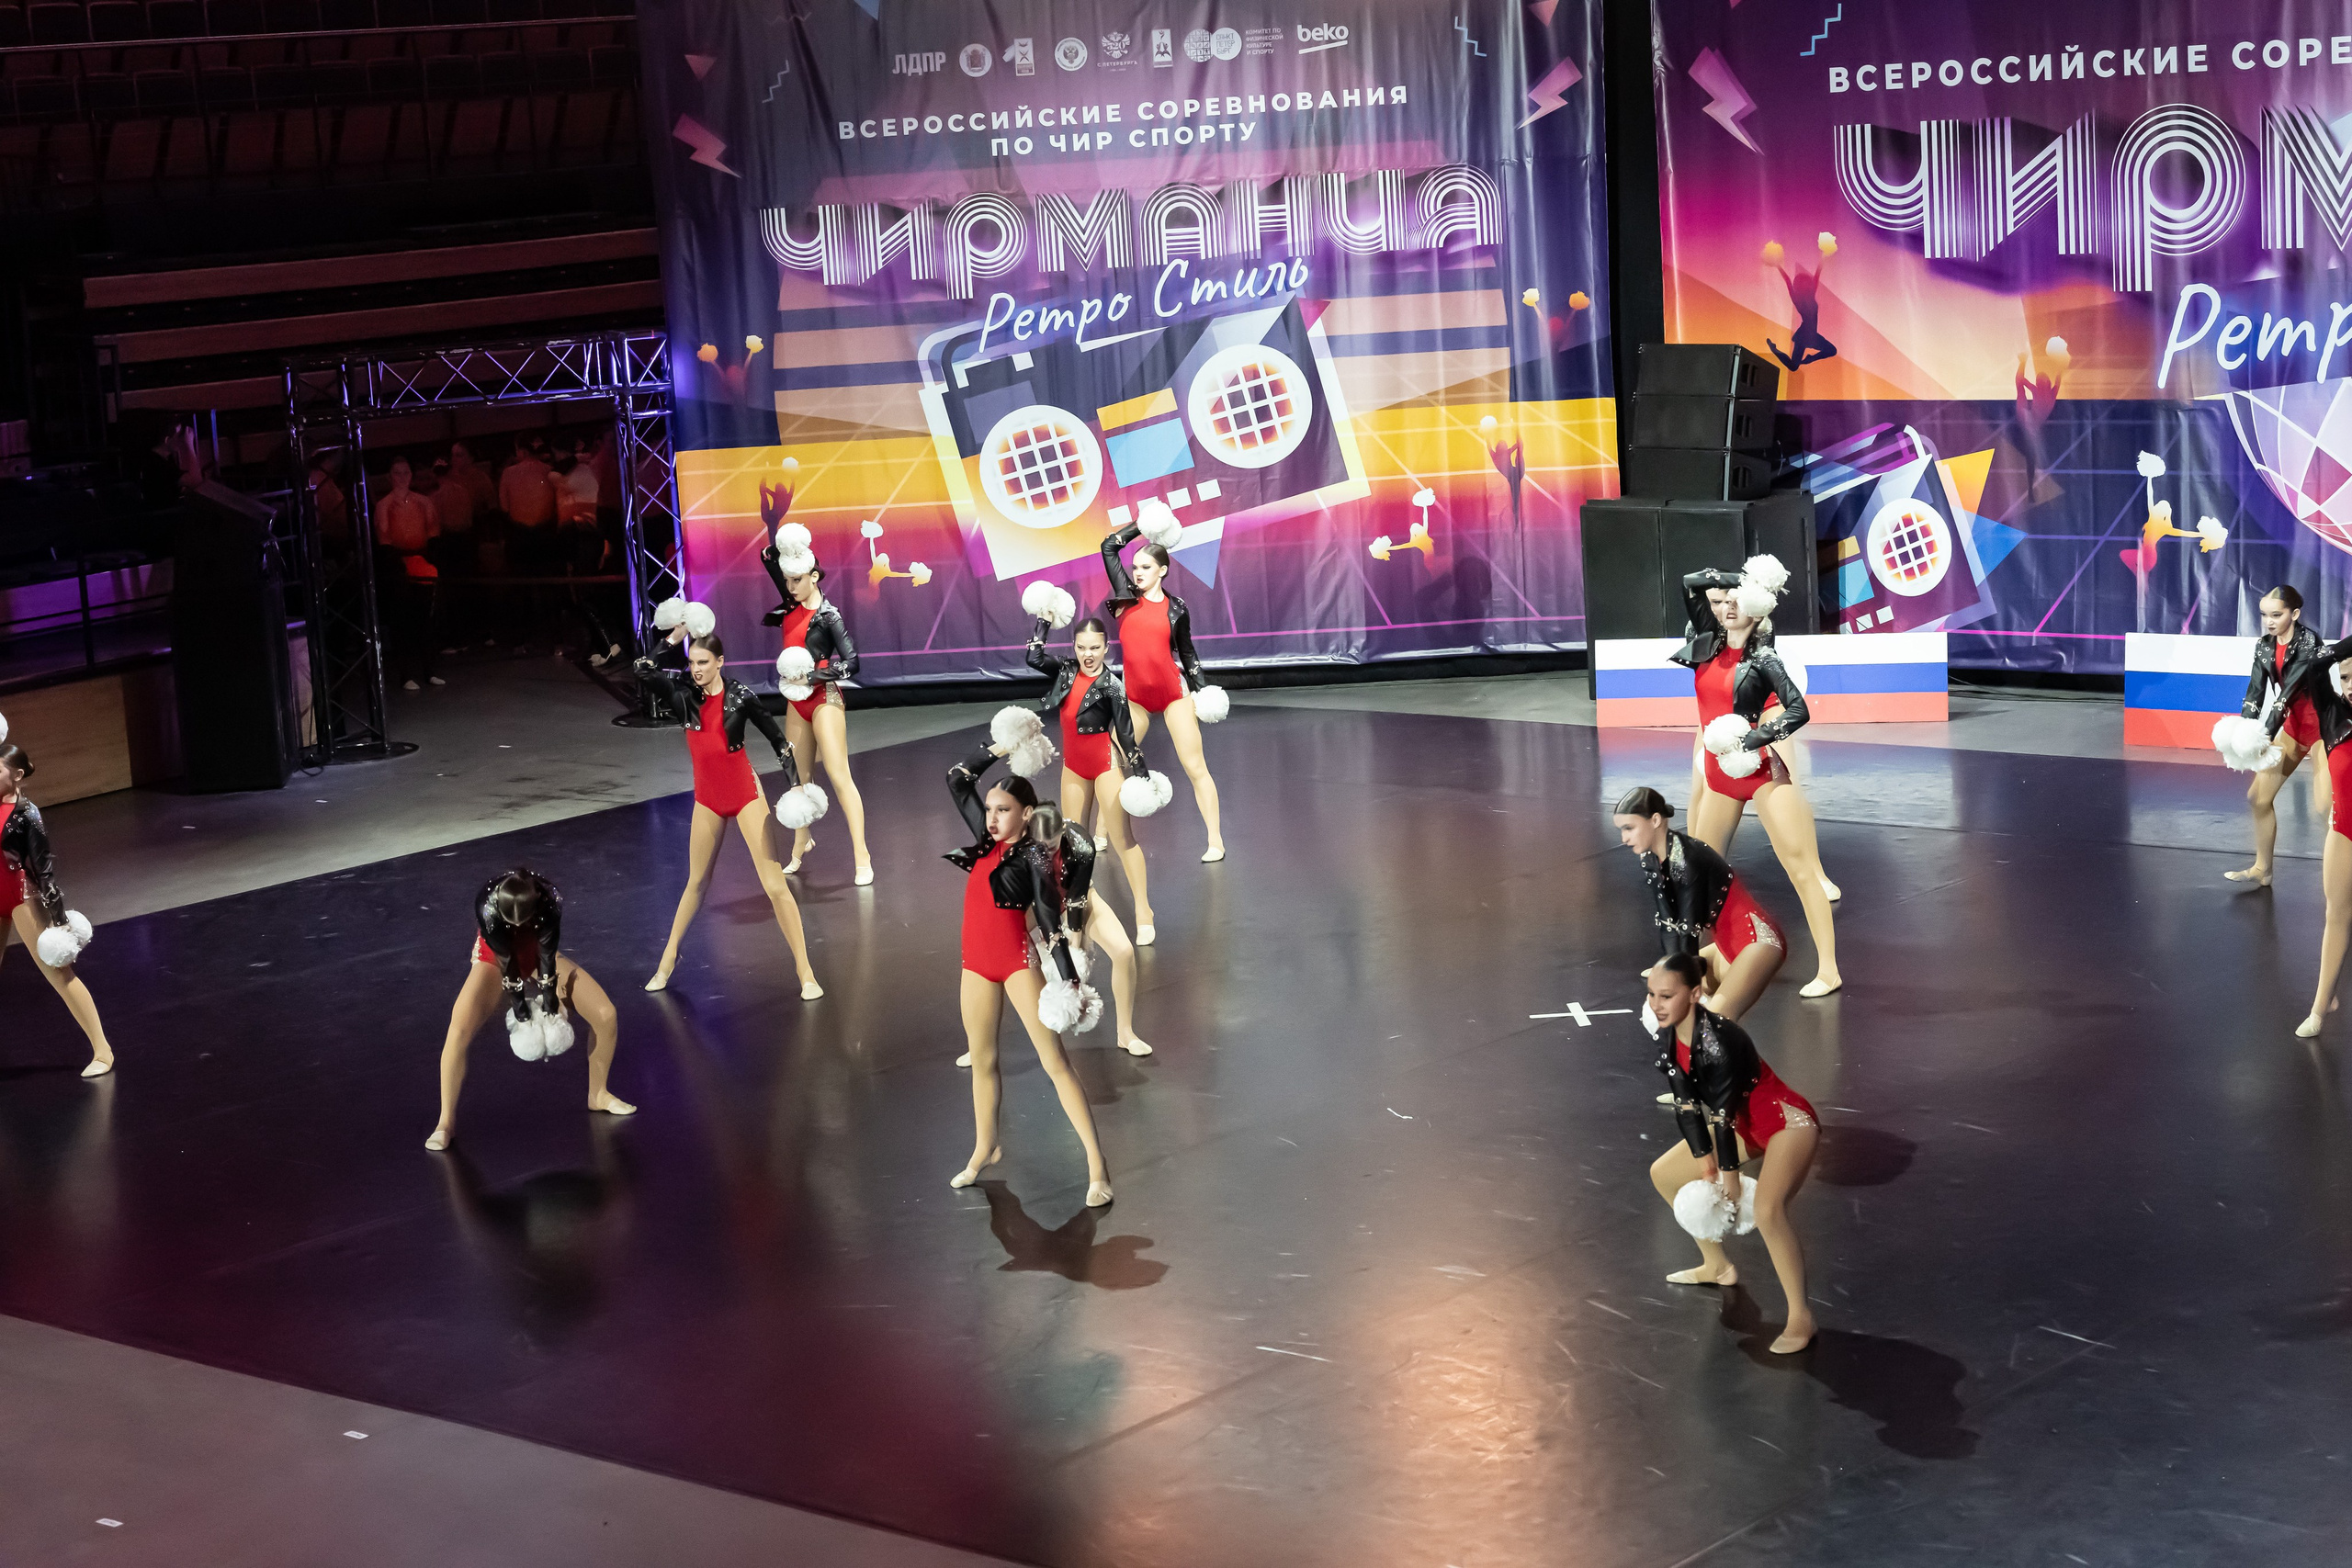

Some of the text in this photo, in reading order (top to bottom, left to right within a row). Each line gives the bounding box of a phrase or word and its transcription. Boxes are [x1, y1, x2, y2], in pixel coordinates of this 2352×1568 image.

[1296, 23, 1349, 42] beko
[892, 51, 946, 76] ЛДПР
[1828, 44, 2208, 93] ВСЕРОССИЙСКИЕ
[838, 85, 1408, 140] ВСЕРОССИЙСКИЕ СОРЕВНОВАНИЯ
[990, 122, 1256, 157] ПО ЧИР СПОРТУ
[978, 257, 1309, 353] Ретро Стиль
